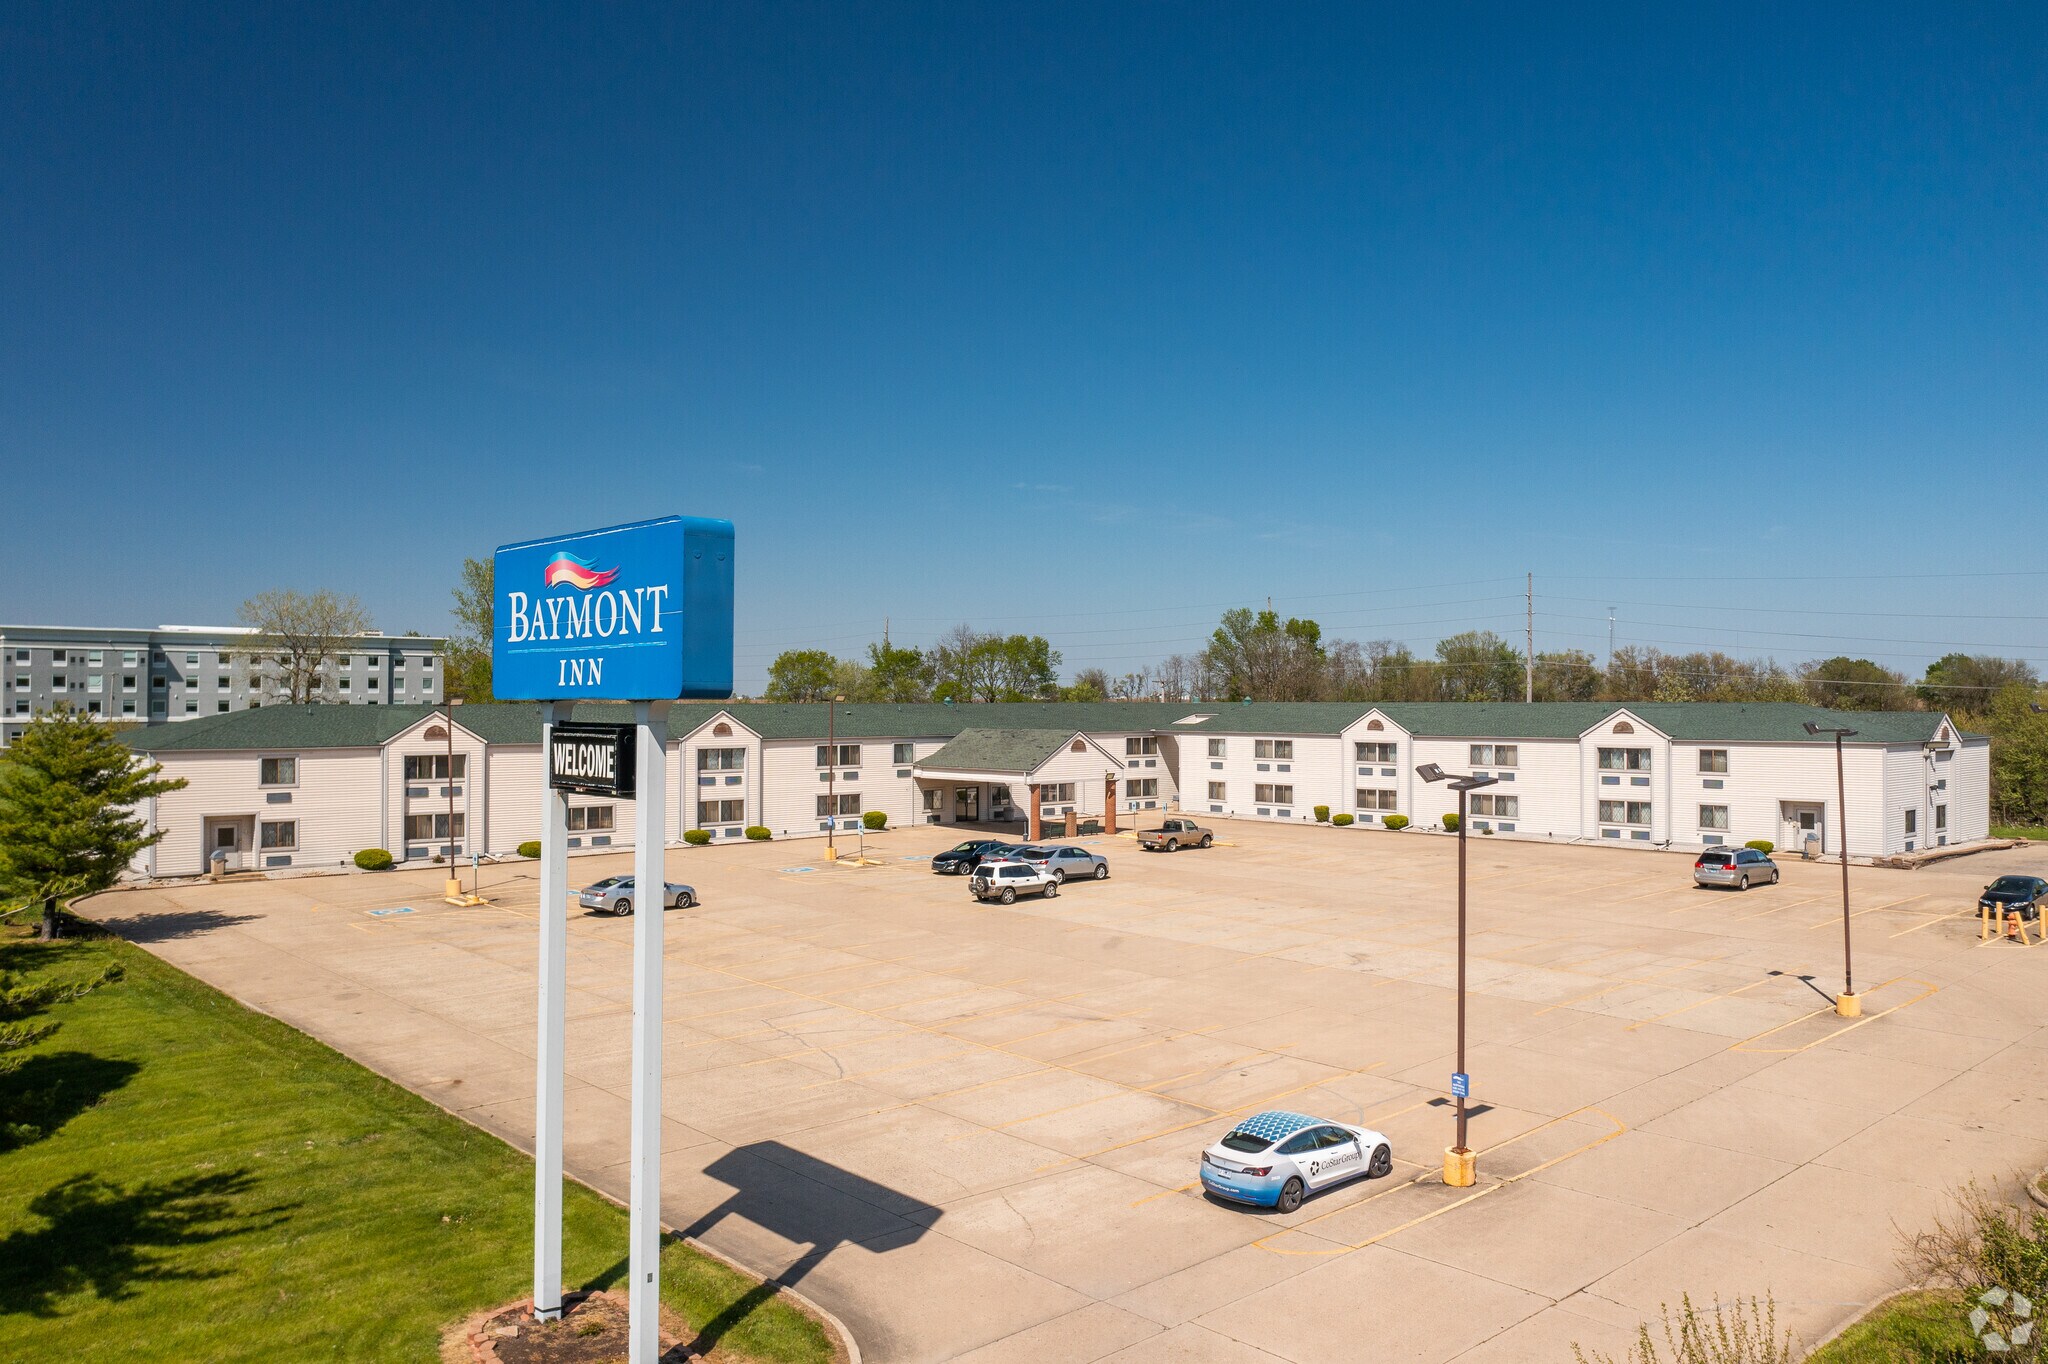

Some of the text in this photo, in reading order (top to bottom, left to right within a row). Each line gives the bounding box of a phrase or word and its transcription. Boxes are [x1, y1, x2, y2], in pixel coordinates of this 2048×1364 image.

[508, 584, 668, 643] BAYMONT
[558, 658, 604, 687] INN
[553, 743, 615, 779] WELCOME
[1321, 1152, 1360, 1170] CoStar Group
